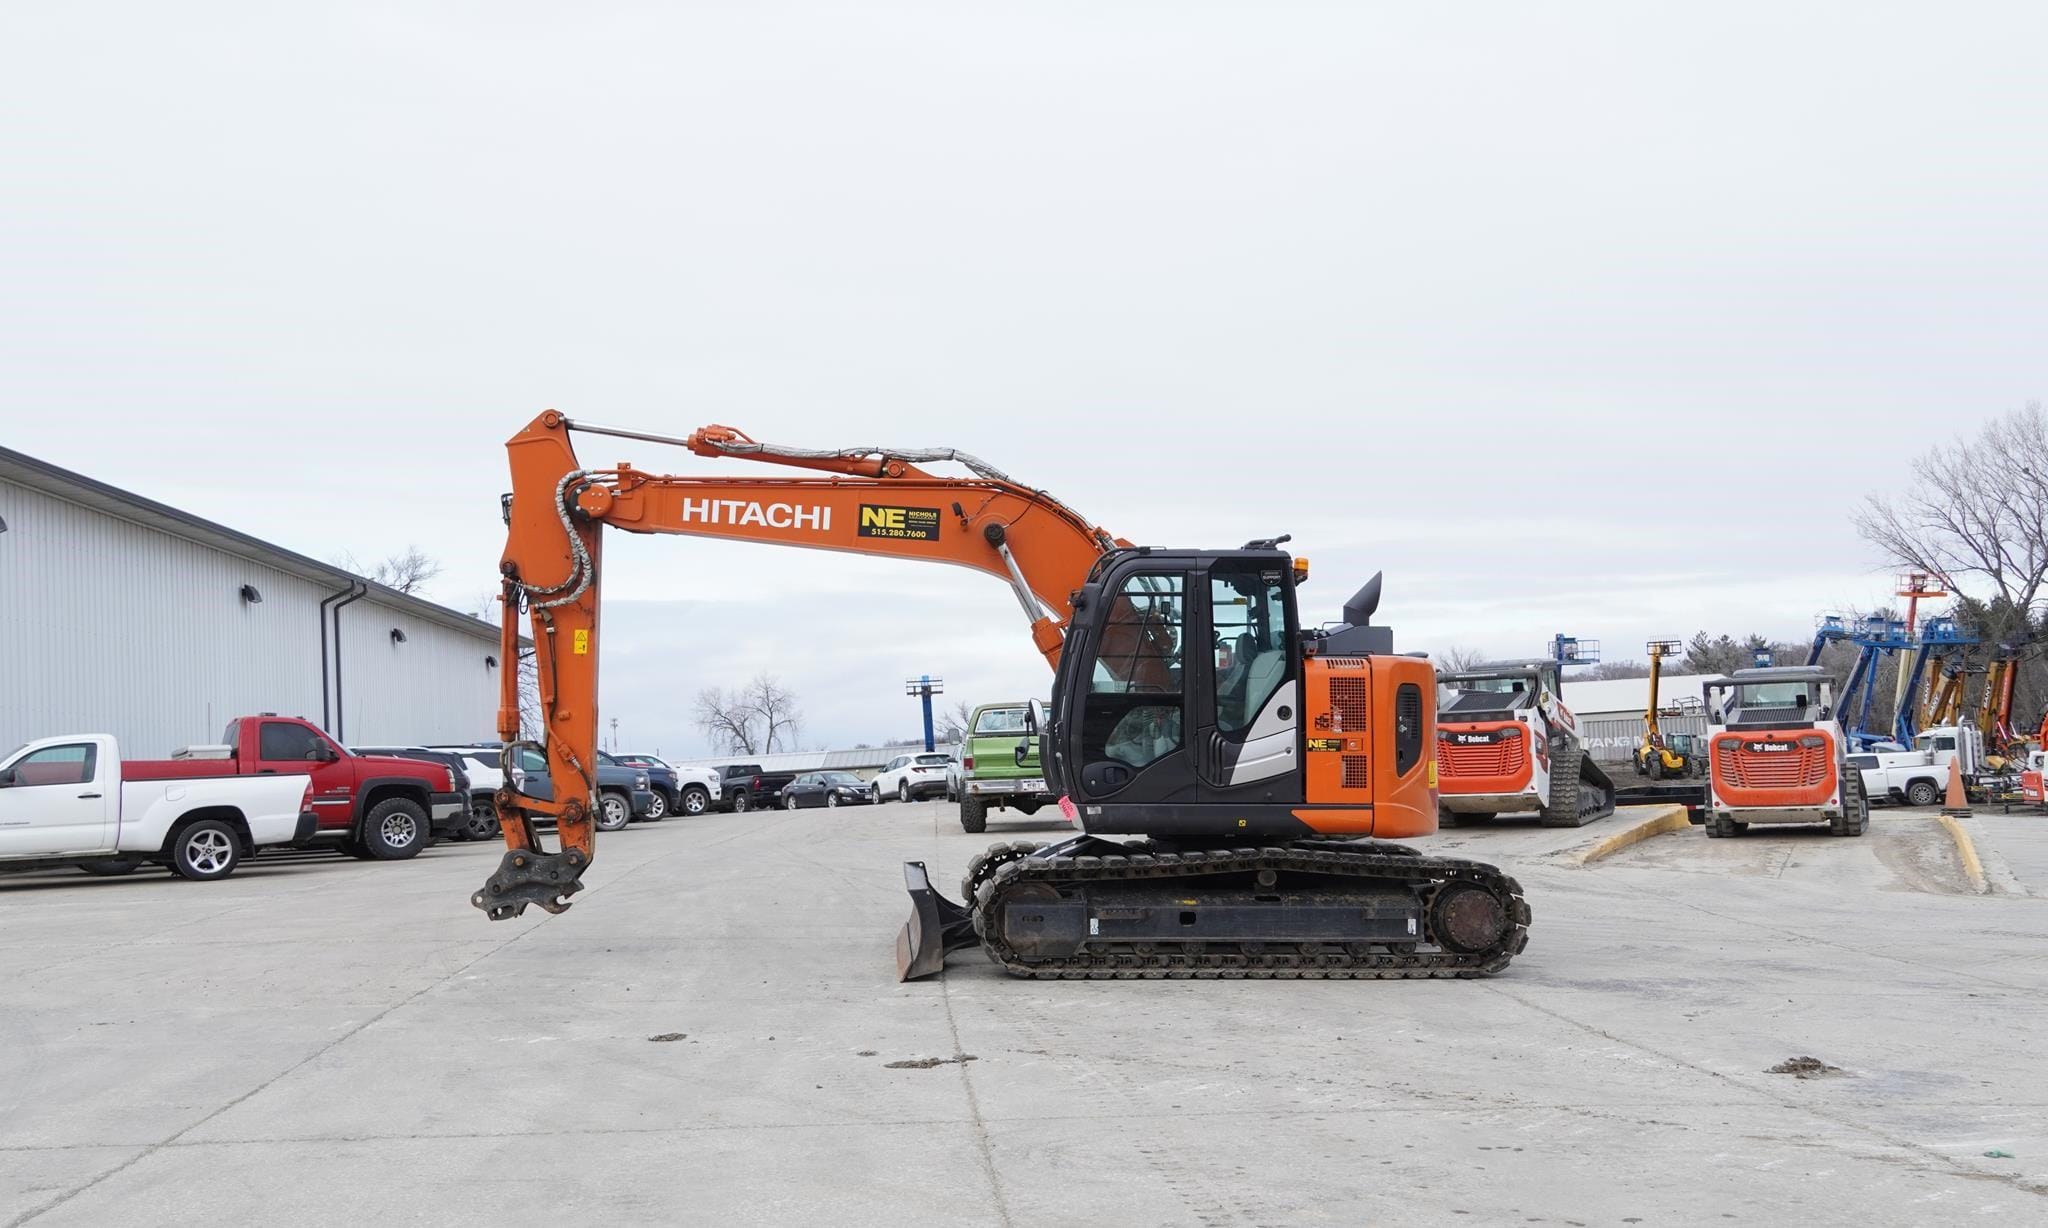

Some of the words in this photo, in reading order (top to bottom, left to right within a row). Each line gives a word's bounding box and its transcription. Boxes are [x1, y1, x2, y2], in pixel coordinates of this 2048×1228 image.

[682, 497, 832, 531] HITACHI
[861, 506, 907, 529] NE
[871, 528, 927, 538] 515.280.7600
[1308, 739, 1328, 748] NE
[1467, 735, 1490, 743] Bobcat
[1764, 743, 1788, 751] Bobcat
